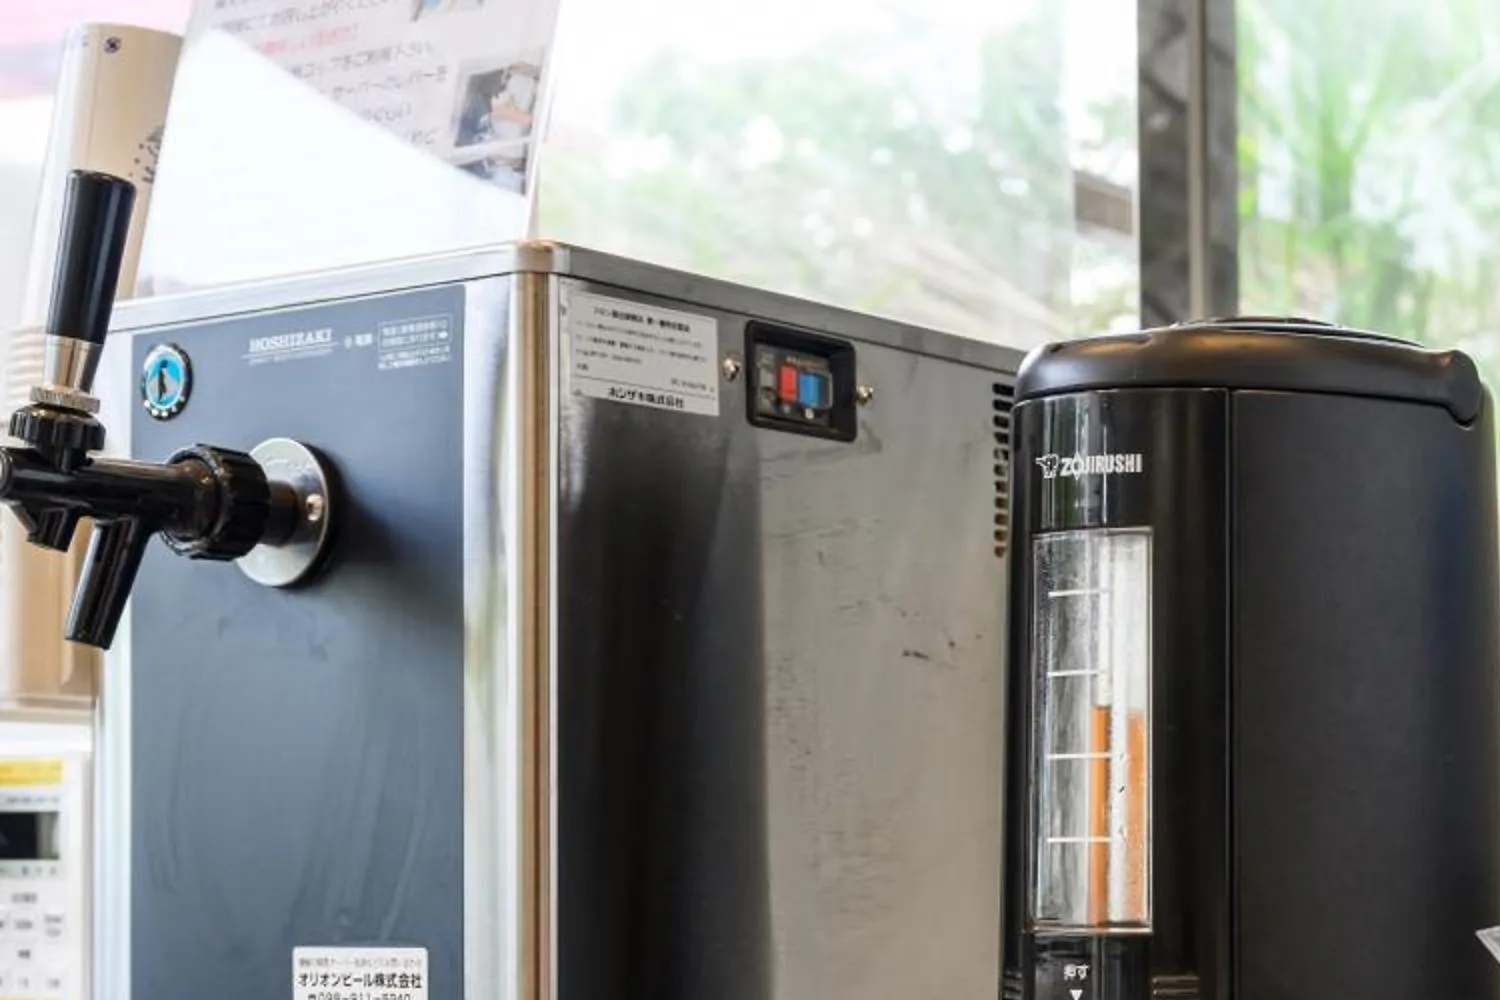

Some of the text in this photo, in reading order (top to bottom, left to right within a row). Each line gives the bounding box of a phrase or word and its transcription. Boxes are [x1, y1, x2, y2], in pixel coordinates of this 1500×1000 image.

[249, 328, 333, 353] HOSHIZAKI
[1060, 452, 1143, 480] ZOJIRUSHI
[297, 972, 423, 989] オリオンビール株式会社
